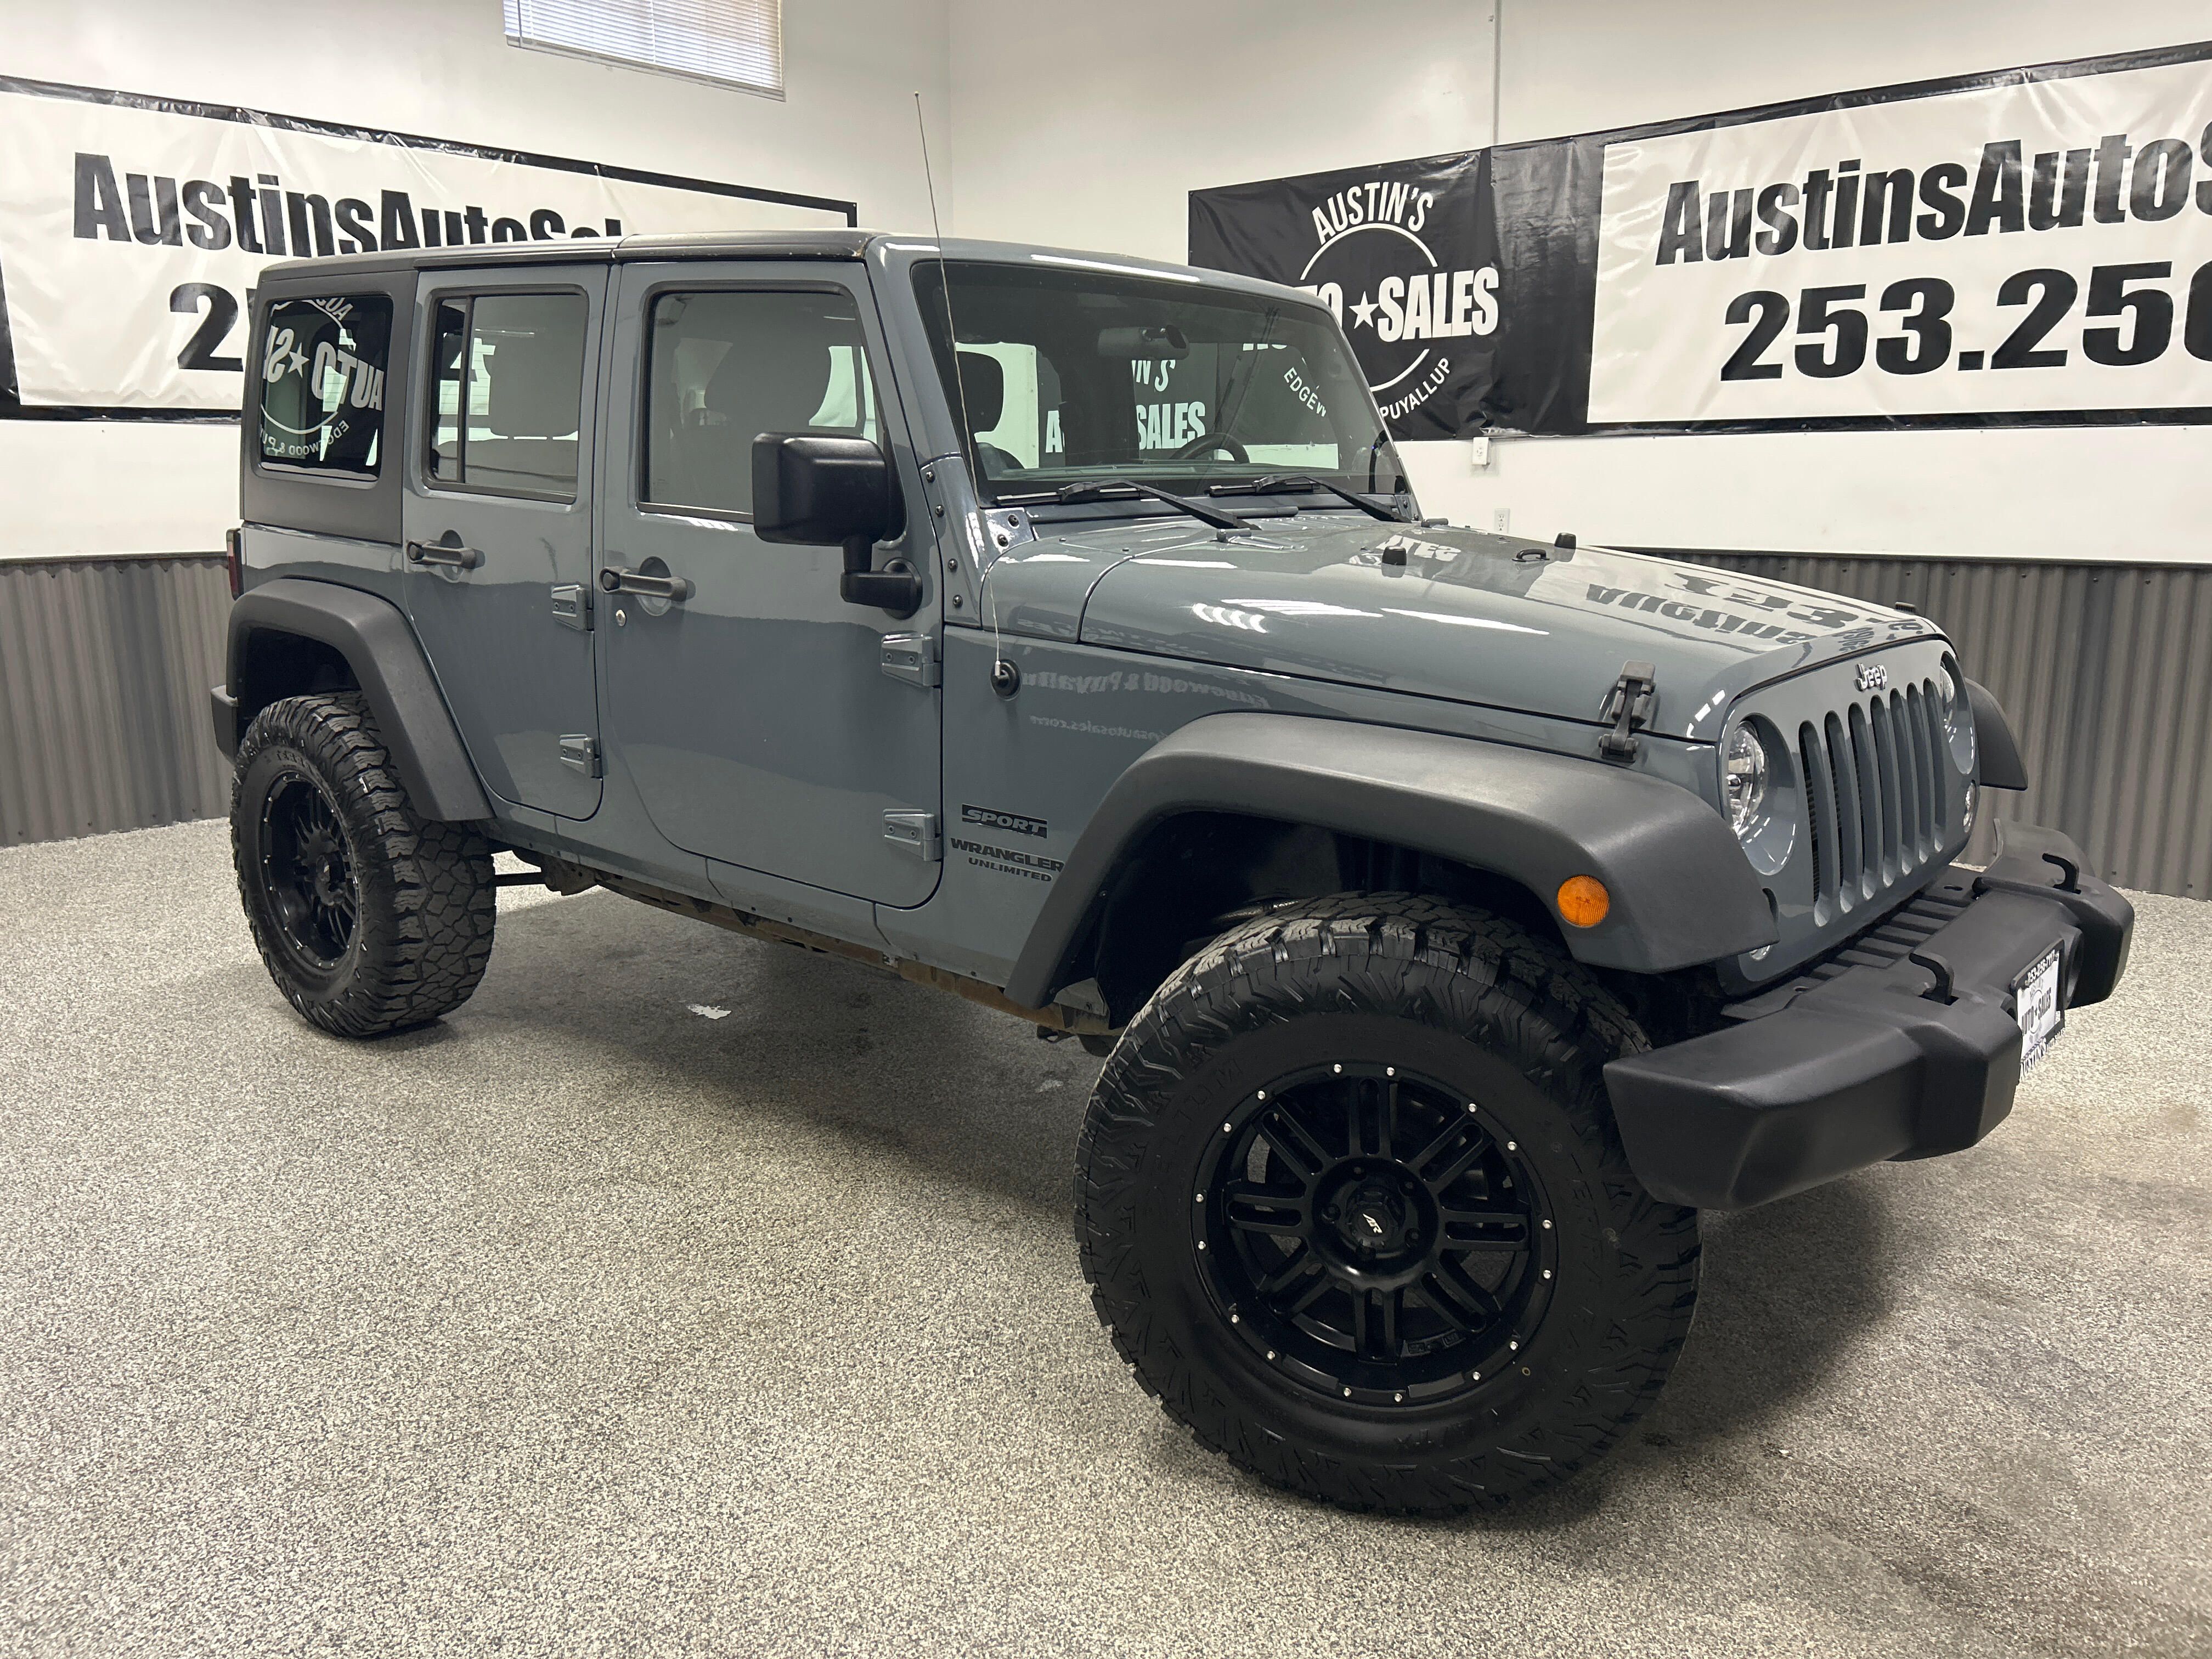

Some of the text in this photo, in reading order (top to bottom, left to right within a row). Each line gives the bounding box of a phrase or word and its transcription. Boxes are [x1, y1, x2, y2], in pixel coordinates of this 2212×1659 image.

[1312, 182, 1433, 245] AUSTIN'S
[1656, 120, 2212, 266] AustinsAuto
[1377, 267, 1499, 343] SALES
[1284, 367, 1327, 417] EDGEW
[1379, 357, 1451, 420] PUYALLUP
[1855, 663, 1888, 690] Jeep
[963, 809, 1048, 833] SPORT
[950, 837, 1065, 873] WRANGLER
[968, 857, 1053, 882] UNLIMITED
